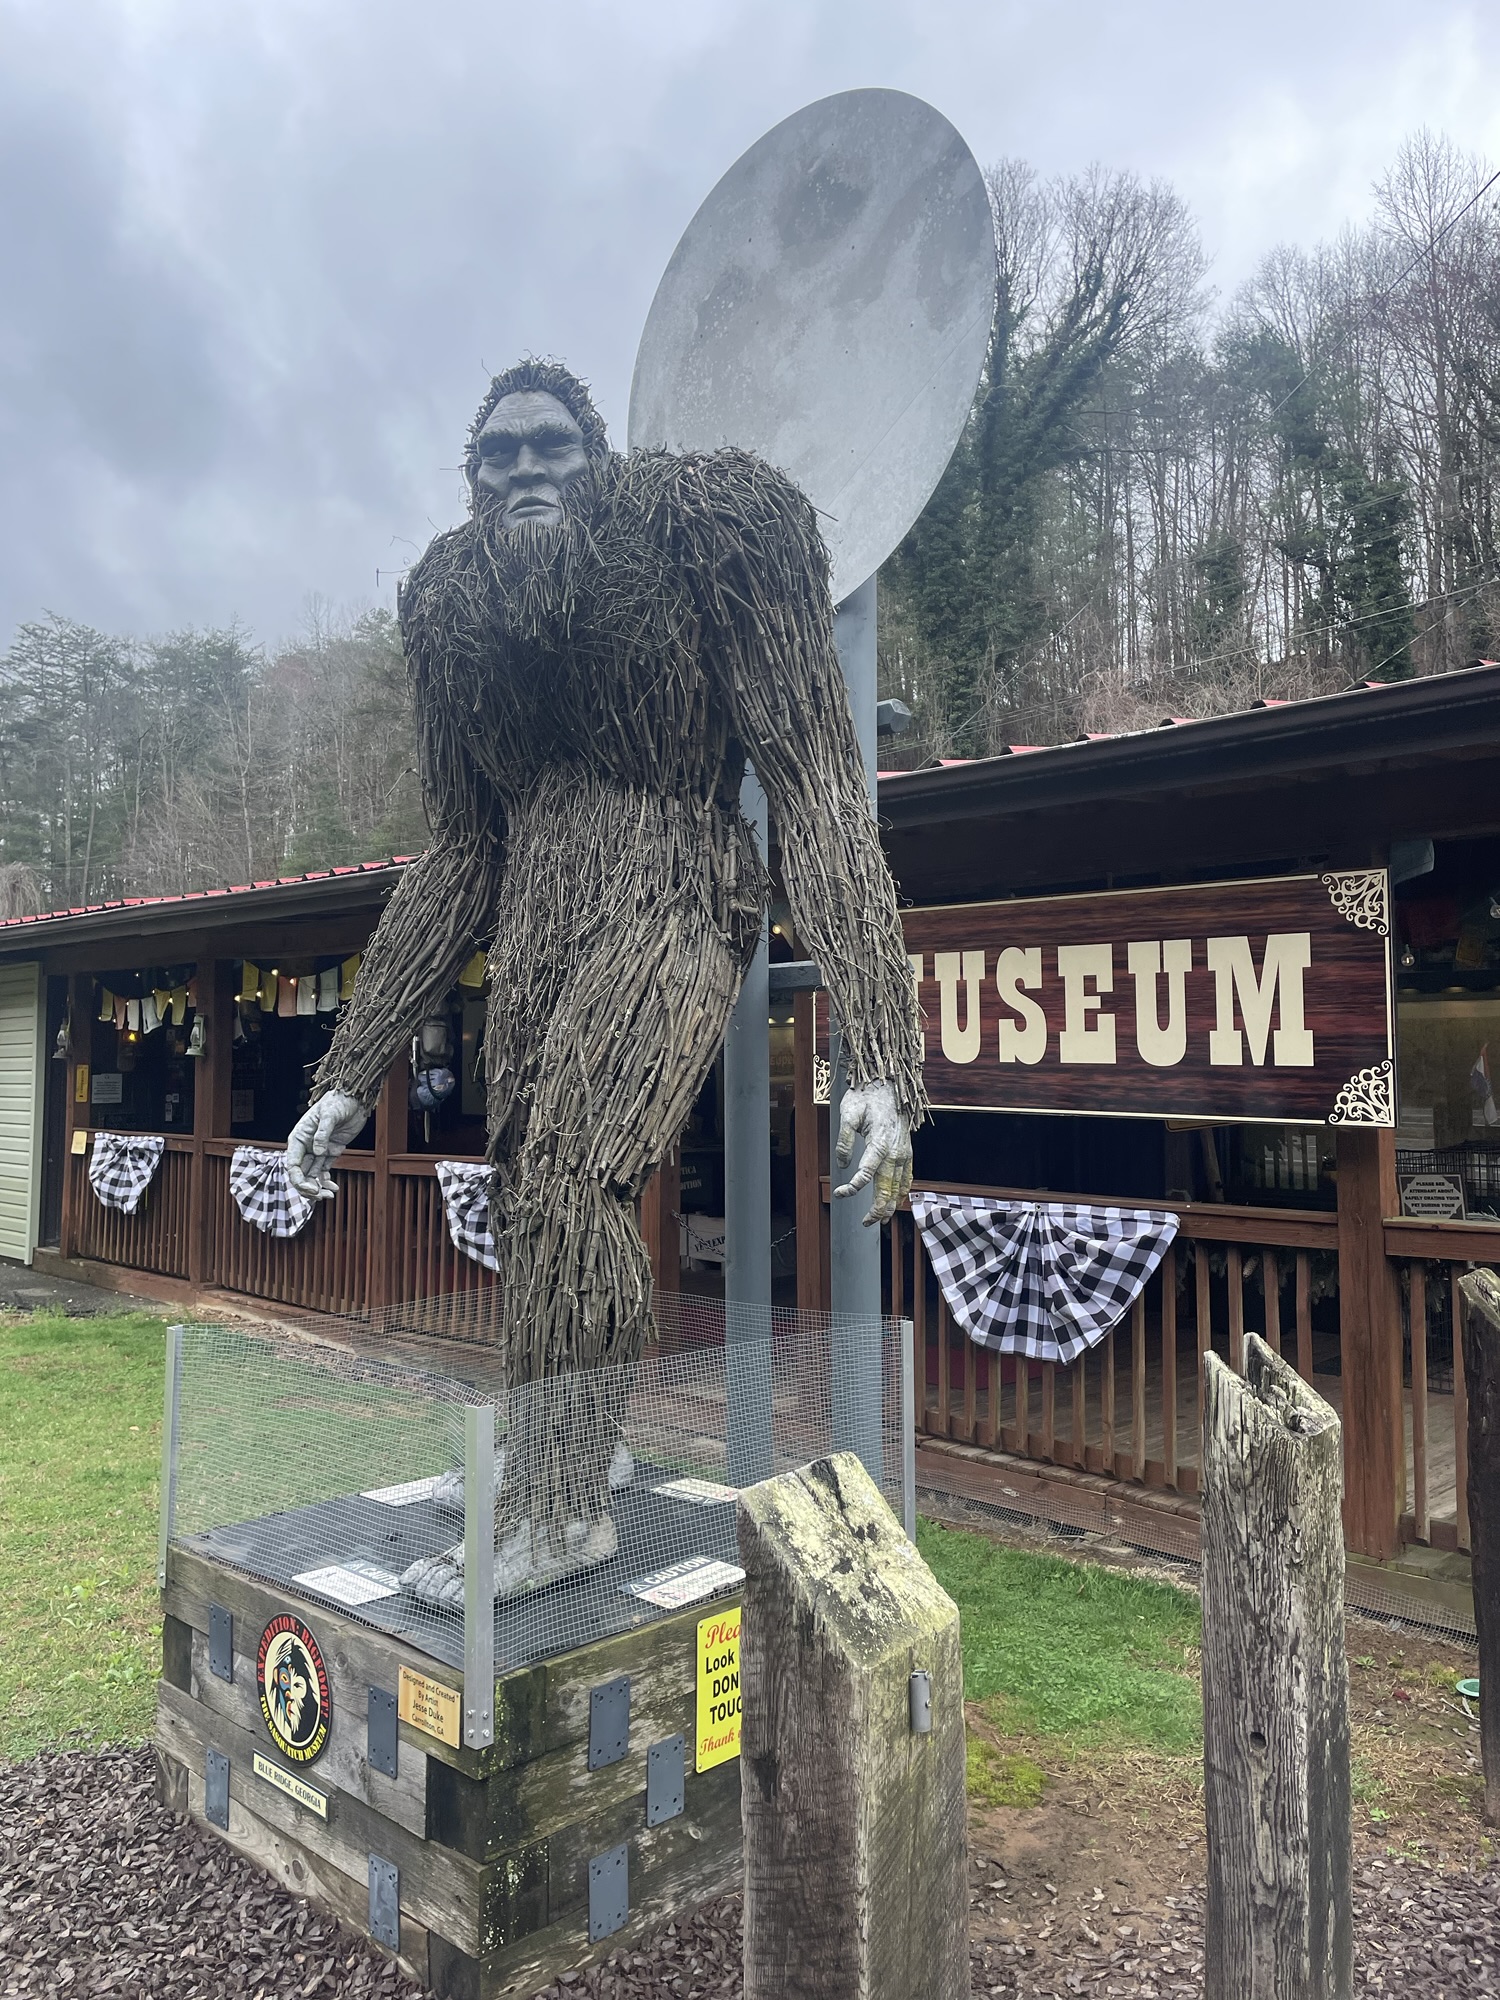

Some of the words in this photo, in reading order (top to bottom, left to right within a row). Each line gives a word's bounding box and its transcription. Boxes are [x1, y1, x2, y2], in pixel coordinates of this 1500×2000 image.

[908, 932, 1314, 1067] USEUM
[643, 1556, 712, 1585] CAUTION
[256, 1616, 300, 1683] EXPEDITION:
[705, 1648, 735, 1675] Look
[402, 1670, 425, 1688] Designed
[425, 1683, 435, 1694] and
[435, 1687, 456, 1703] Created
[418, 1690, 425, 1701] By
[425, 1694, 439, 1707] Artist
[412, 1699, 428, 1715] Jesse
[428, 1707, 444, 1723] Duke
[259, 1694, 271, 1722] THE
[267, 1720, 304, 1761] SASQUATCH
[303, 1723, 327, 1761] MUSEUM
[436, 1726, 445, 1736] GA
[699, 1726, 735, 1756] Thank
[258, 1761, 273, 1778] BLUE
[273, 1770, 294, 1793] RIDGE,
[294, 1785, 322, 1809] GEORGIA
